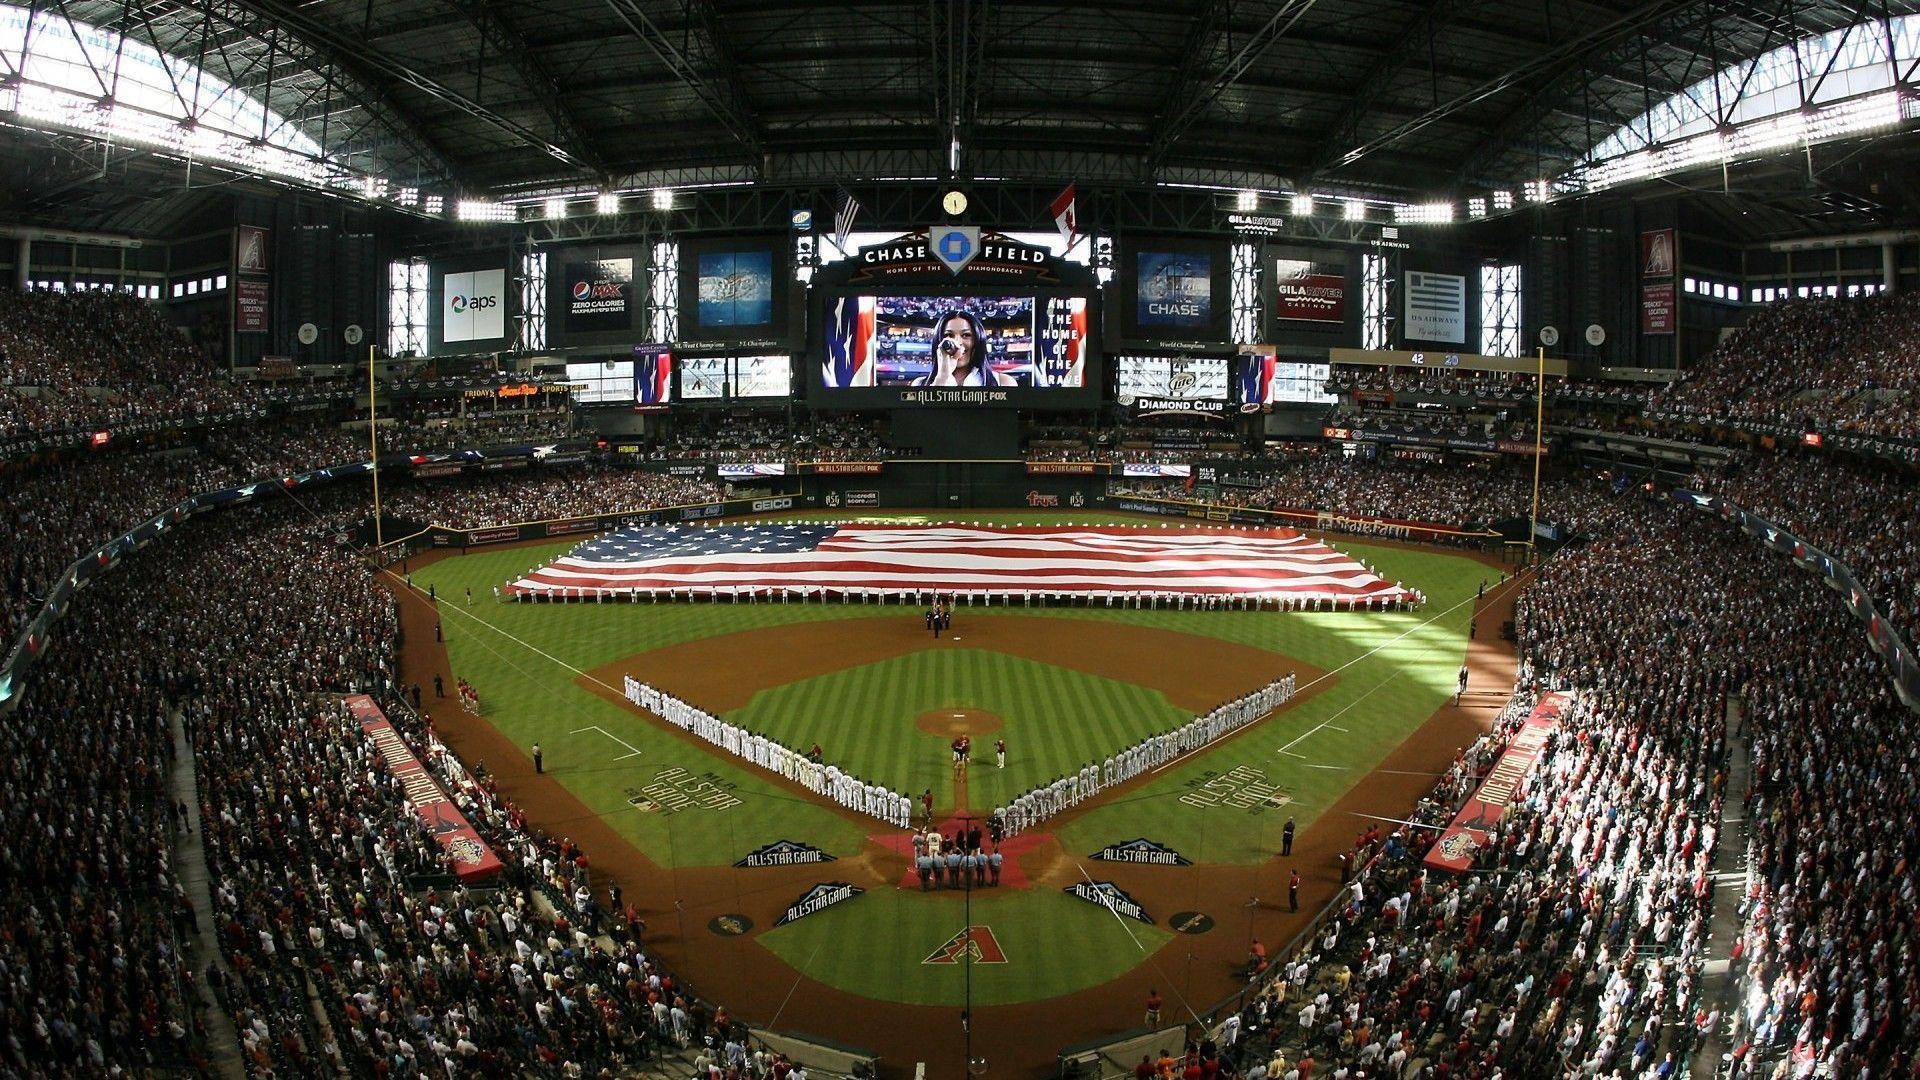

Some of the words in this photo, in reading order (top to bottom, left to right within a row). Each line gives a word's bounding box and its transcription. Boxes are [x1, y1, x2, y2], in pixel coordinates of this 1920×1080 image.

[1228, 216, 1252, 224] GILA
[1252, 217, 1283, 226] RIVER
[864, 246, 926, 263] CHASE
[985, 246, 1045, 263] FIELD
[886, 266, 908, 274] HOME
[968, 265, 1023, 275] DIAMONDBACKS
[591, 284, 624, 297] MAX
[1279, 285, 1306, 294] GILA
[1306, 287, 1343, 298] RIVER
[469, 295, 496, 311] aps
[1048, 300, 1072, 309] AND
[1148, 304, 1199, 316] CHASE
[1049, 315, 1072, 324] THE
[1425, 315, 1458, 324] AIRWAYS
[1042, 330, 1078, 340] HOME
[696, 341, 725, 349] Champions
[1052, 345, 1067, 354] OF
[1048, 360, 1072, 369] THE
[1412, 353, 1424, 364] 42
[1445, 355, 1460, 366] 20
[1172, 376, 1194, 391] Lite
[465, 390, 495, 398] FRIDAY'S
[918, 391, 936, 404] ALL
[936, 391, 961, 402] STAR
[962, 391, 988, 404] GAME
[989, 392, 1007, 400] FOX
[1139, 400, 1191, 410] DIAMOND
[1194, 401, 1223, 410] CLUB
[1394, 450, 1434, 460] UPTOWN
[754, 500, 791, 510] GEICO
[621, 515, 650, 524] CHASE
[370, 727, 414, 768] NATIONAL
[1475, 754, 1530, 806] AMERICAN
[395, 766, 448, 808] LEAGUE
[653, 767, 698, 788] ALL
[684, 781, 744, 811] STAR
[1178, 788, 1228, 809] ALL
[1204, 765, 1268, 792] STAR
[642, 782, 702, 812] GAME
[1222, 779, 1281, 809] GAME
[794, 850, 822, 864] GAME
[1150, 851, 1178, 865] GAME
[828, 883, 853, 905] GAME
[1115, 898, 1142, 919] GAME
